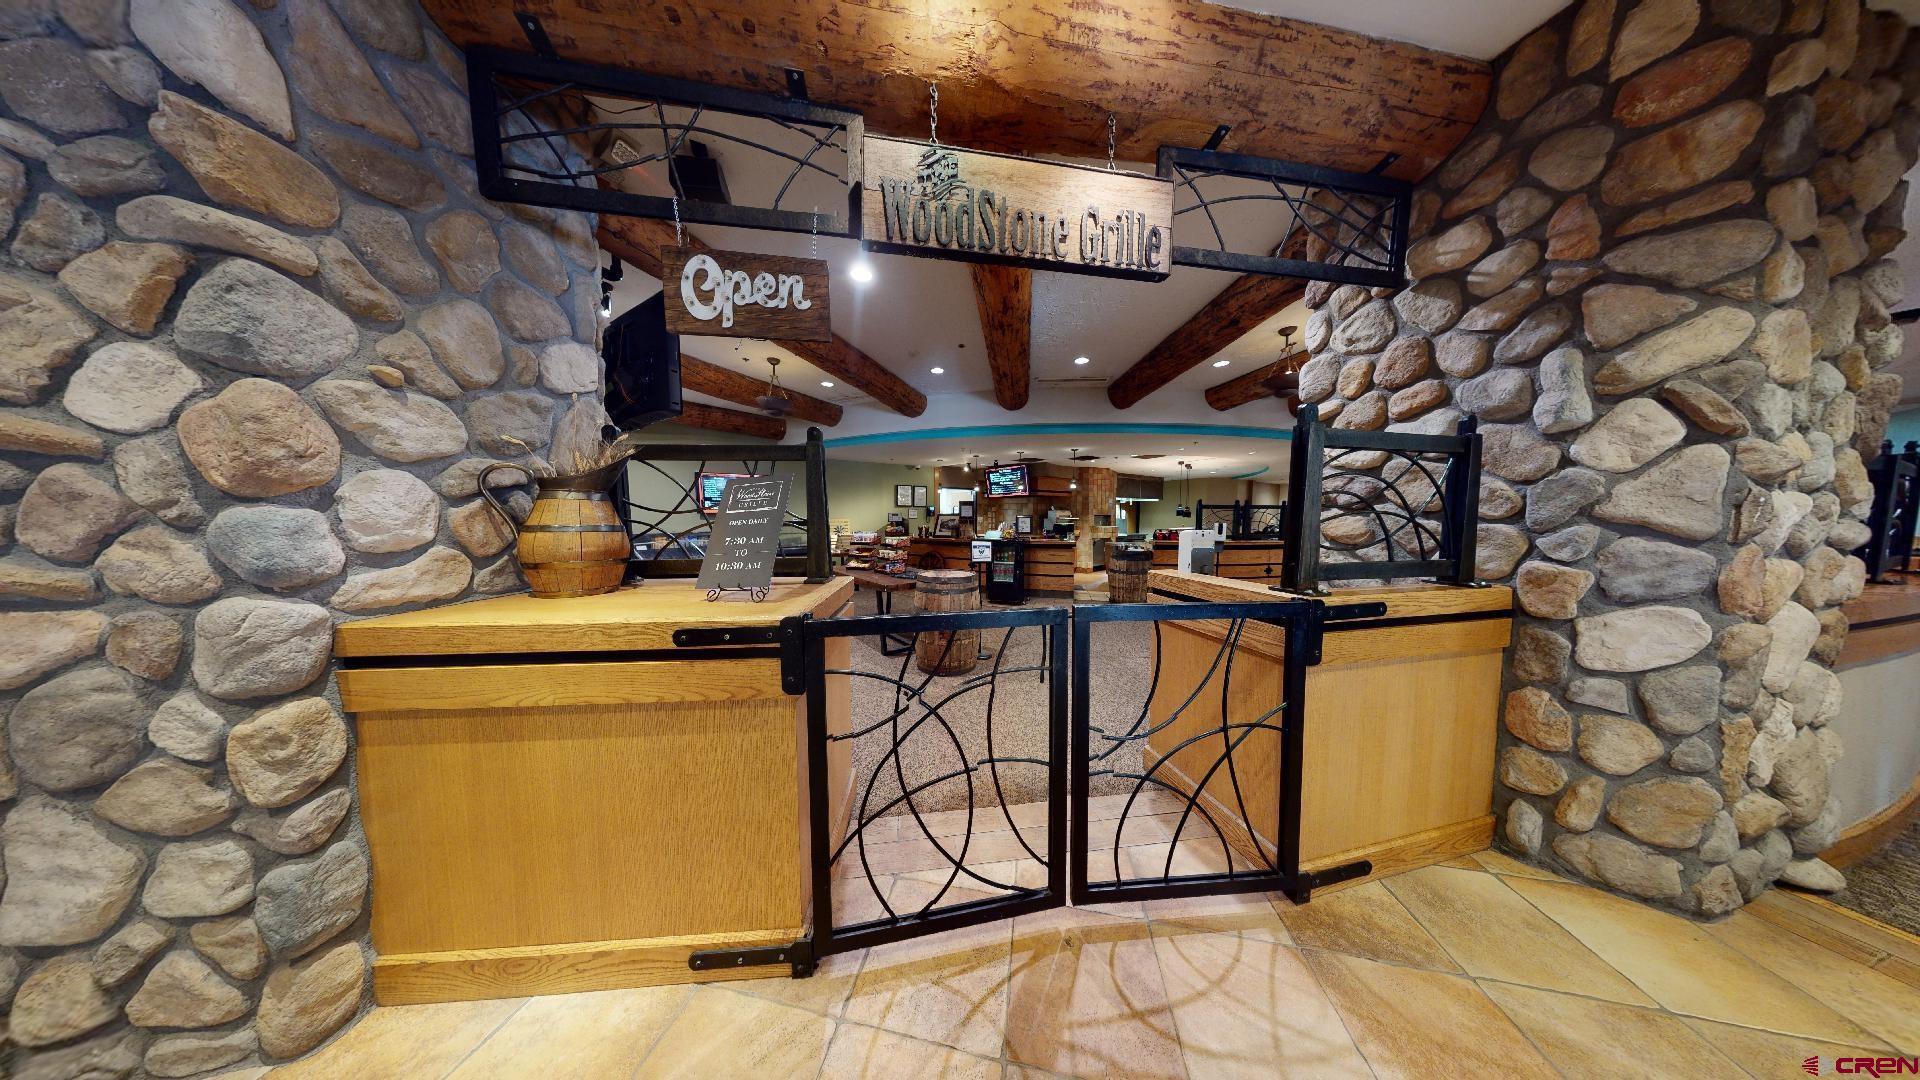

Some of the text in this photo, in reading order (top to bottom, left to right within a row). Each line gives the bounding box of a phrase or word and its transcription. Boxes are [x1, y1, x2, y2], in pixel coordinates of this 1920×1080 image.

[878, 175, 1162, 270] WoodStone Grille
[680, 253, 812, 328] Open
[748, 517, 769, 525] DAILY
[725, 536, 765, 546] 7:30 AM
[734, 548, 748, 557] TO
[715, 561, 762, 571] 10:30 AM
